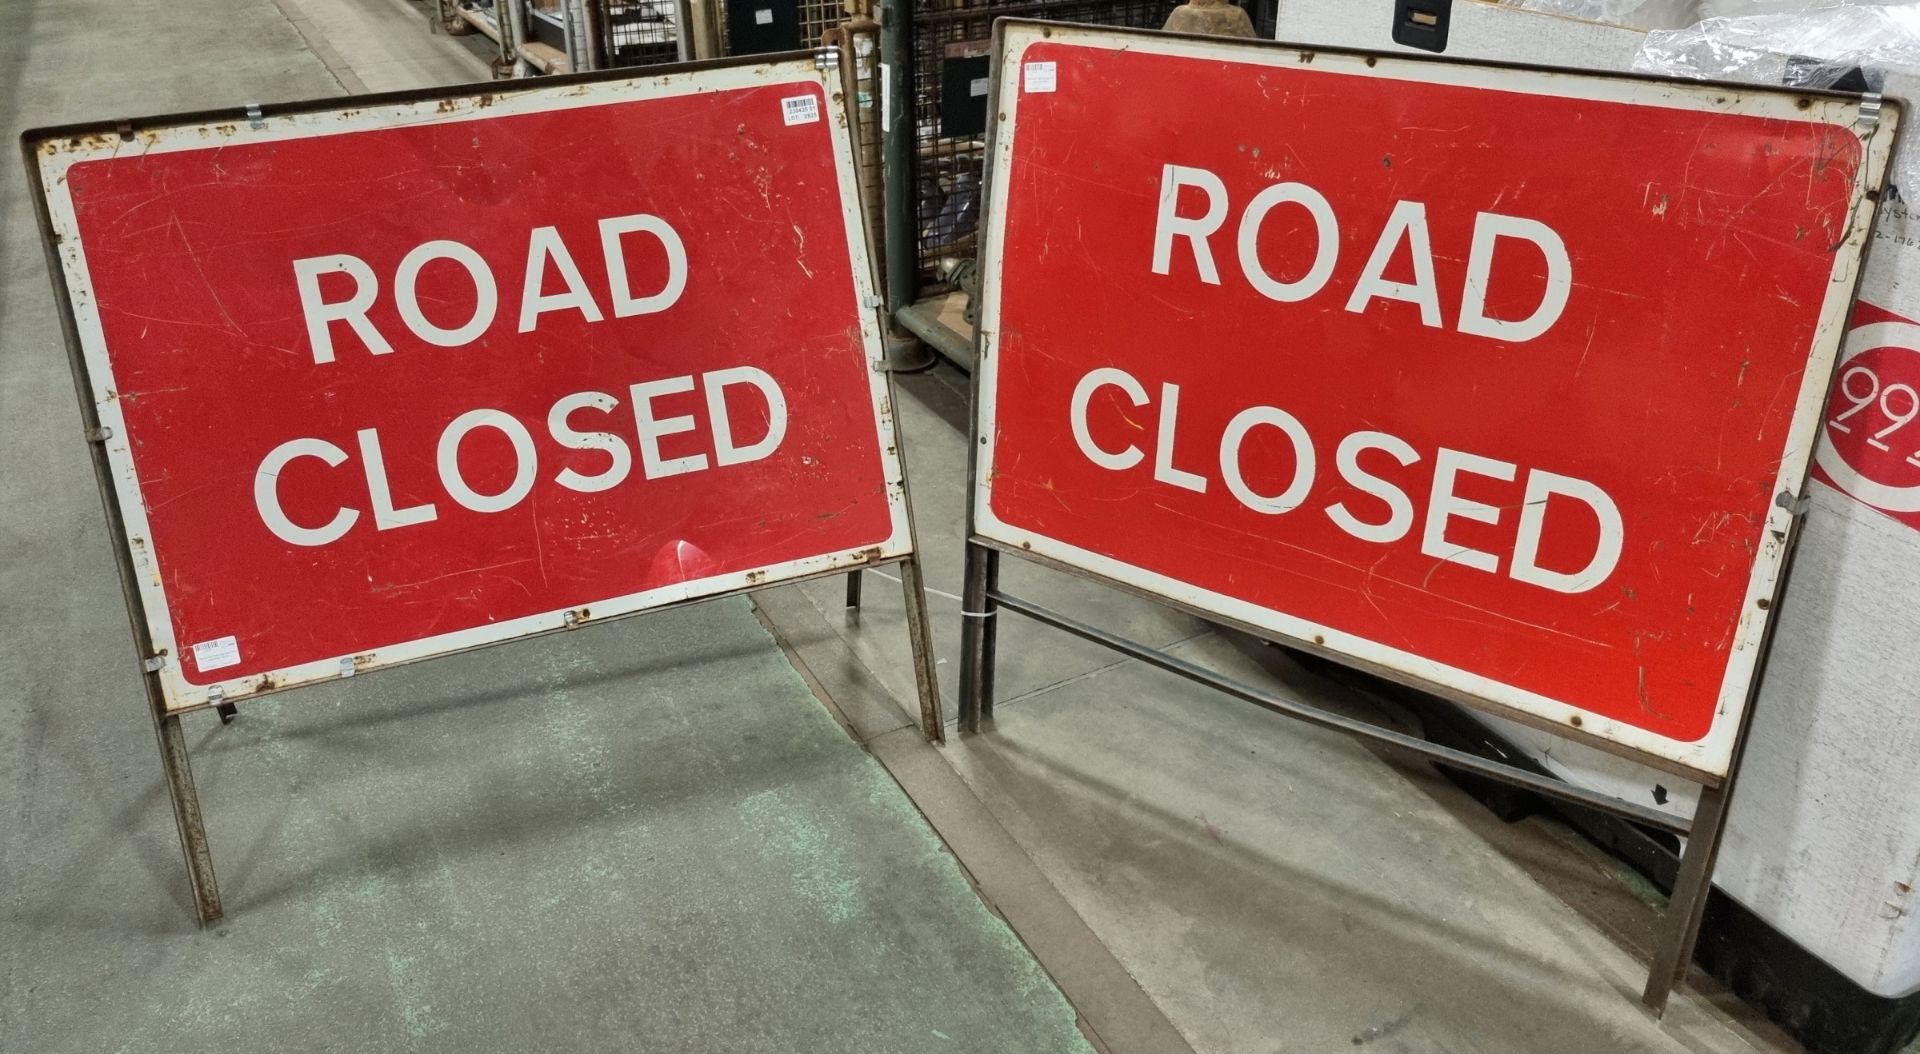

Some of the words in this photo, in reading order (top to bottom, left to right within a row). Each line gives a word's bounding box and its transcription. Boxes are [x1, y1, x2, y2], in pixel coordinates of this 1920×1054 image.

[293, 214, 690, 364] ROAD
[1152, 164, 1572, 342] ROAD
[254, 366, 787, 546] CLOSED
[1071, 368, 1623, 593] CLOSED
